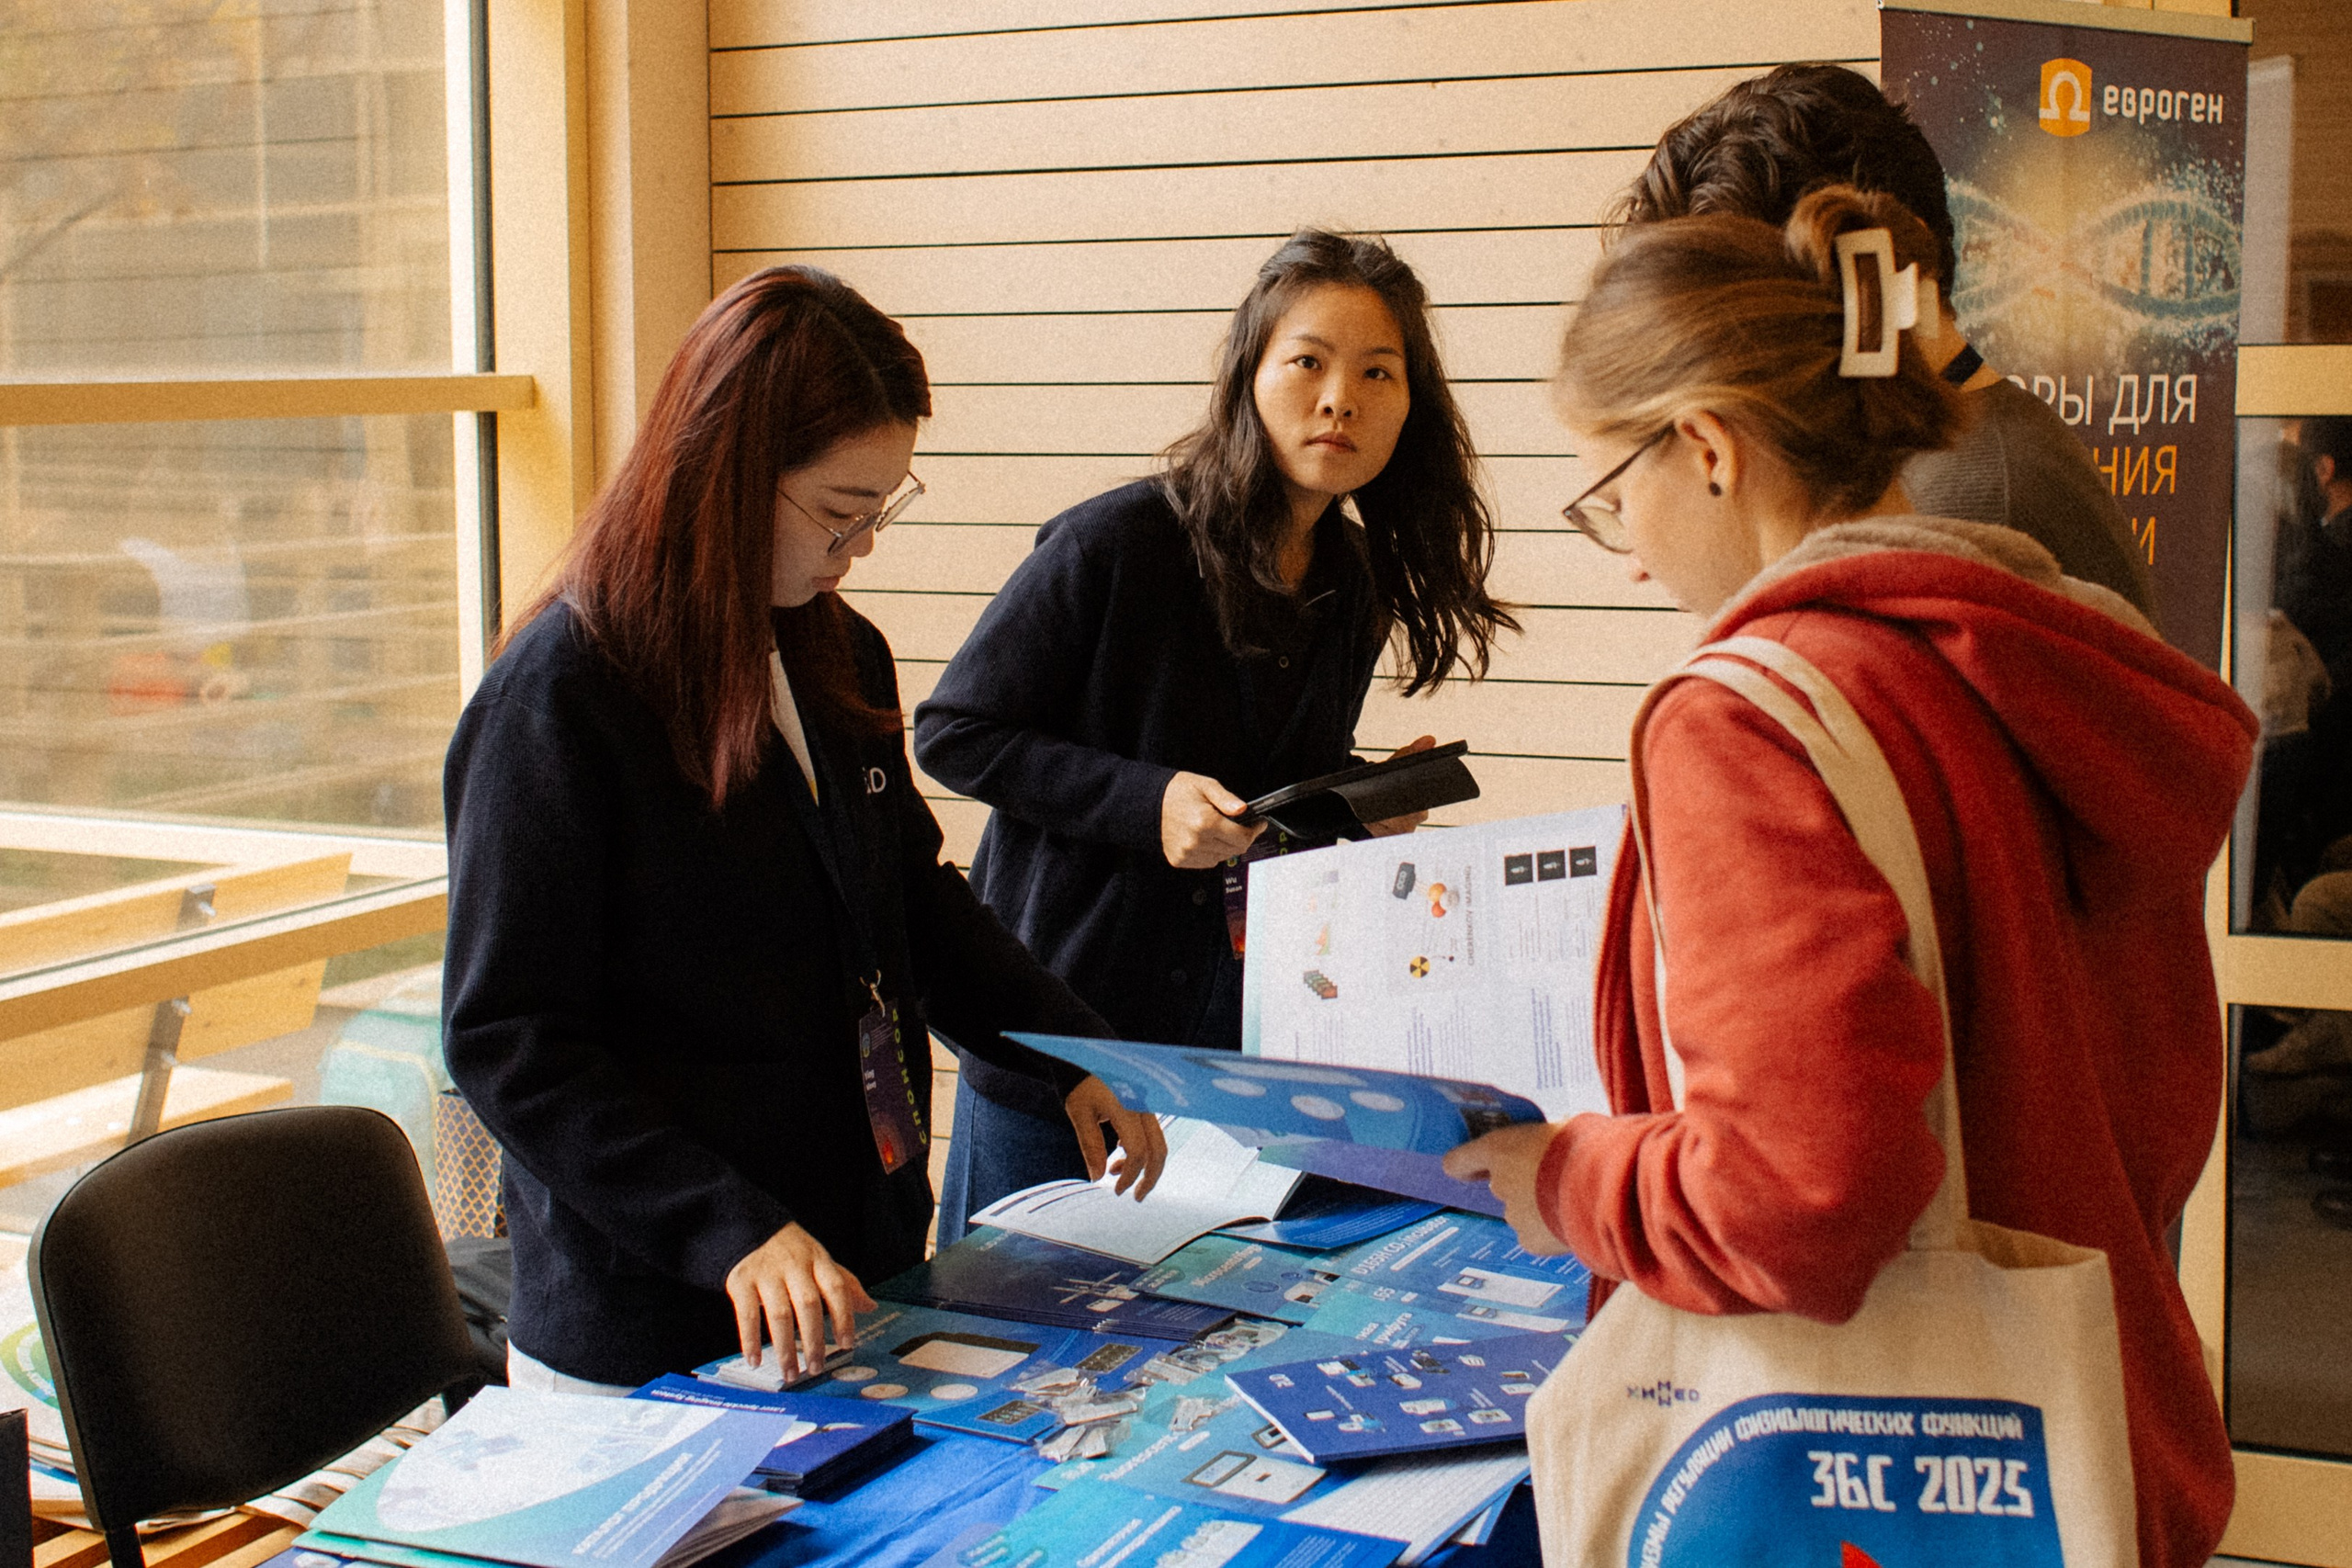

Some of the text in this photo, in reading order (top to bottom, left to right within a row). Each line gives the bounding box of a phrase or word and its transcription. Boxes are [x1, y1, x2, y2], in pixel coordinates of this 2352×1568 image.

[2103, 85, 2223, 125] евроген
[2108, 373, 2198, 436] ДЛЯ
[891, 1008, 928, 1145] СПОНСОР
[1921, 1410, 2024, 1440] ФУНКЦИЙ
[1914, 1454, 2035, 1518] 2025
